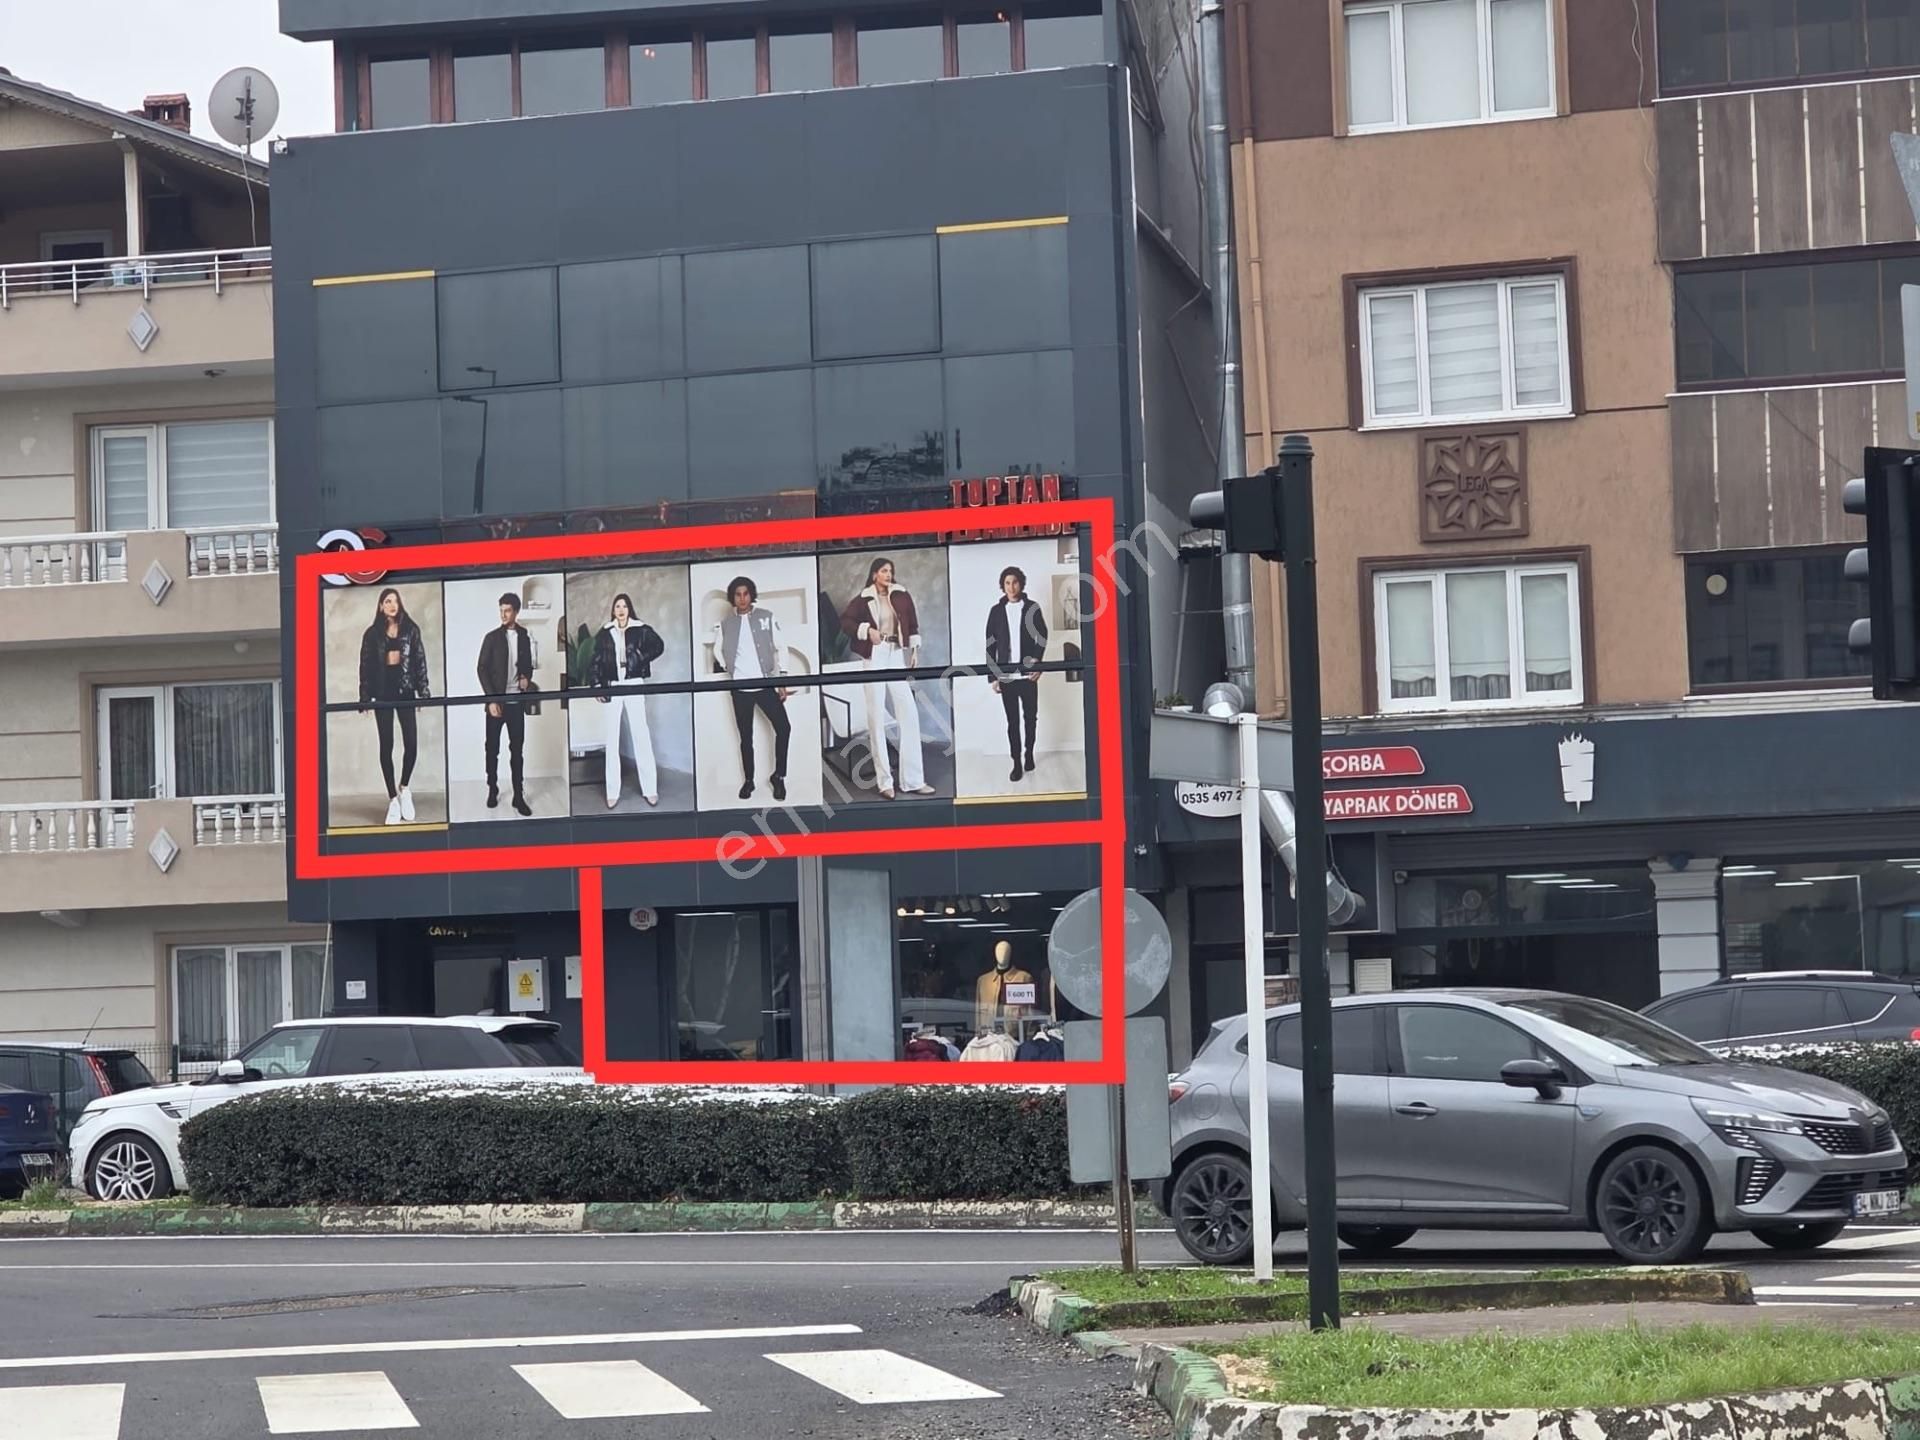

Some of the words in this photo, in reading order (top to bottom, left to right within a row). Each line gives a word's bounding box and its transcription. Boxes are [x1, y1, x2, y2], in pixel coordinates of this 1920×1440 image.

[1323, 753, 1386, 778] ÇORBA
[1182, 793, 1209, 804] 0535
[1213, 791, 1233, 802] 497
[1323, 795, 1391, 815] YAPRAK
[1396, 789, 1459, 812] DÖNER
